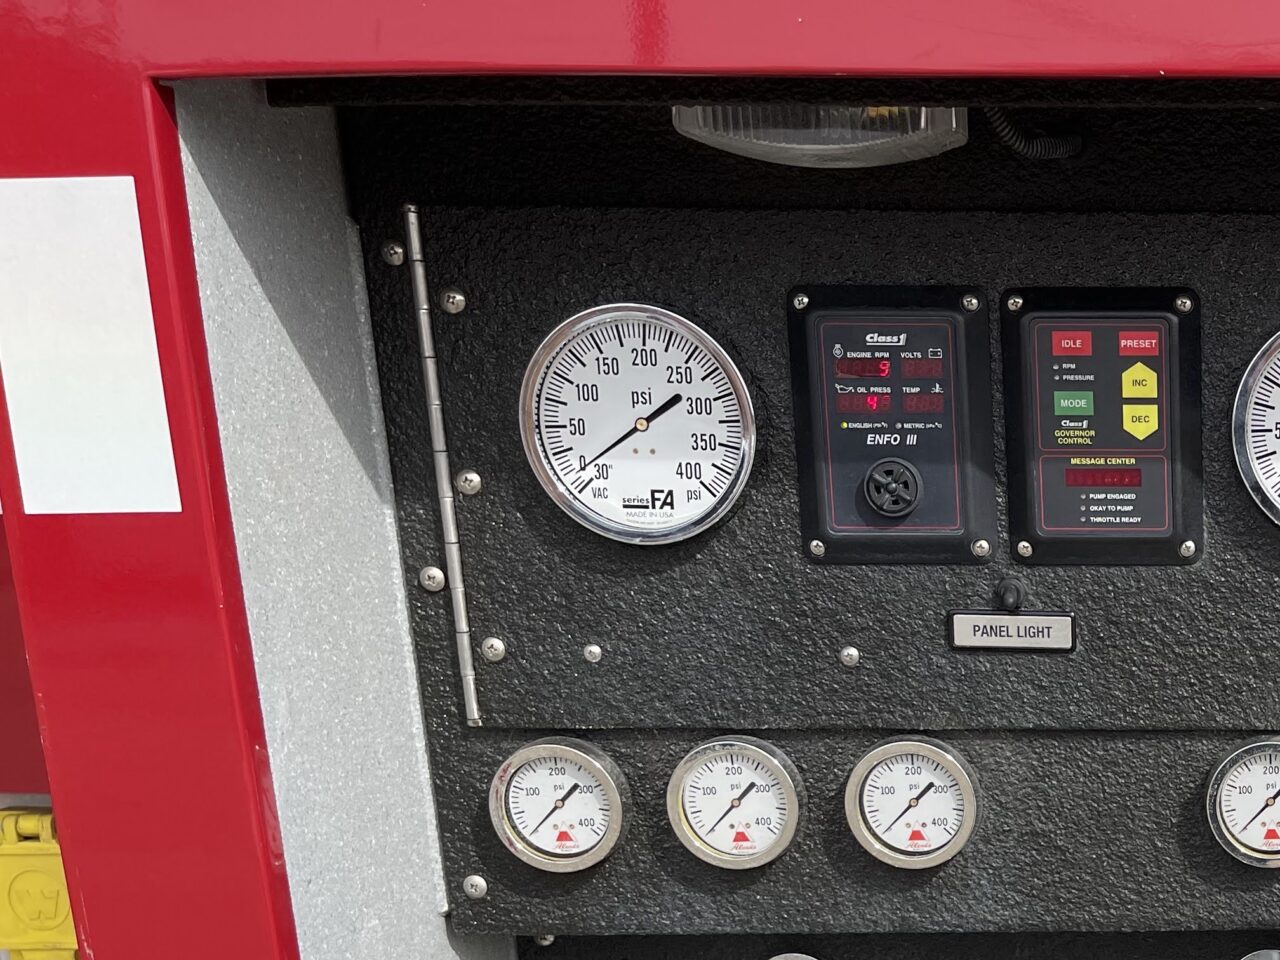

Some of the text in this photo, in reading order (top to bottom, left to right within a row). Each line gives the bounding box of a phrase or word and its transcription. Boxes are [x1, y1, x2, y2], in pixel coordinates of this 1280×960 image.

[865, 333, 907, 345] Class1
[1061, 340, 1082, 348] IDLE
[1121, 340, 1157, 348] PRESET
[631, 349, 658, 366] 200
[595, 357, 620, 376] 150
[666, 366, 693, 384] 250
[1132, 379, 1148, 387] INC
[575, 384, 599, 402] 100
[631, 387, 653, 408] psi
[686, 398, 713, 415] 300
[1061, 399, 1087, 407] MODE
[1131, 415, 1150, 423] DEC
[569, 419, 586, 436] 50
[691, 433, 717, 451] 350
[866, 434, 917, 445] ENFO III
[1058, 437, 1092, 445] CONTROL
[675, 462, 701, 480] 400
[591, 486, 609, 499] VAC
[686, 489, 701, 503] psi
[622, 489, 674, 510] series FA
[973, 624, 1053, 639] PANEL LIGHT
[548, 767, 566, 776] 200
[725, 766, 742, 776] 200
[1263, 765, 1280, 775] 200
[525, 787, 540, 796] 100
[553, 784, 565, 792] psi
[578, 785, 594, 794] 300
[702, 786, 717, 796] 100
[730, 782, 742, 791] psi
[755, 784, 770, 793] 300
[1238, 785, 1253, 795] 100
[1266, 782, 1277, 791] psi
[578, 818, 595, 827] 400
[754, 817, 772, 826] 400
